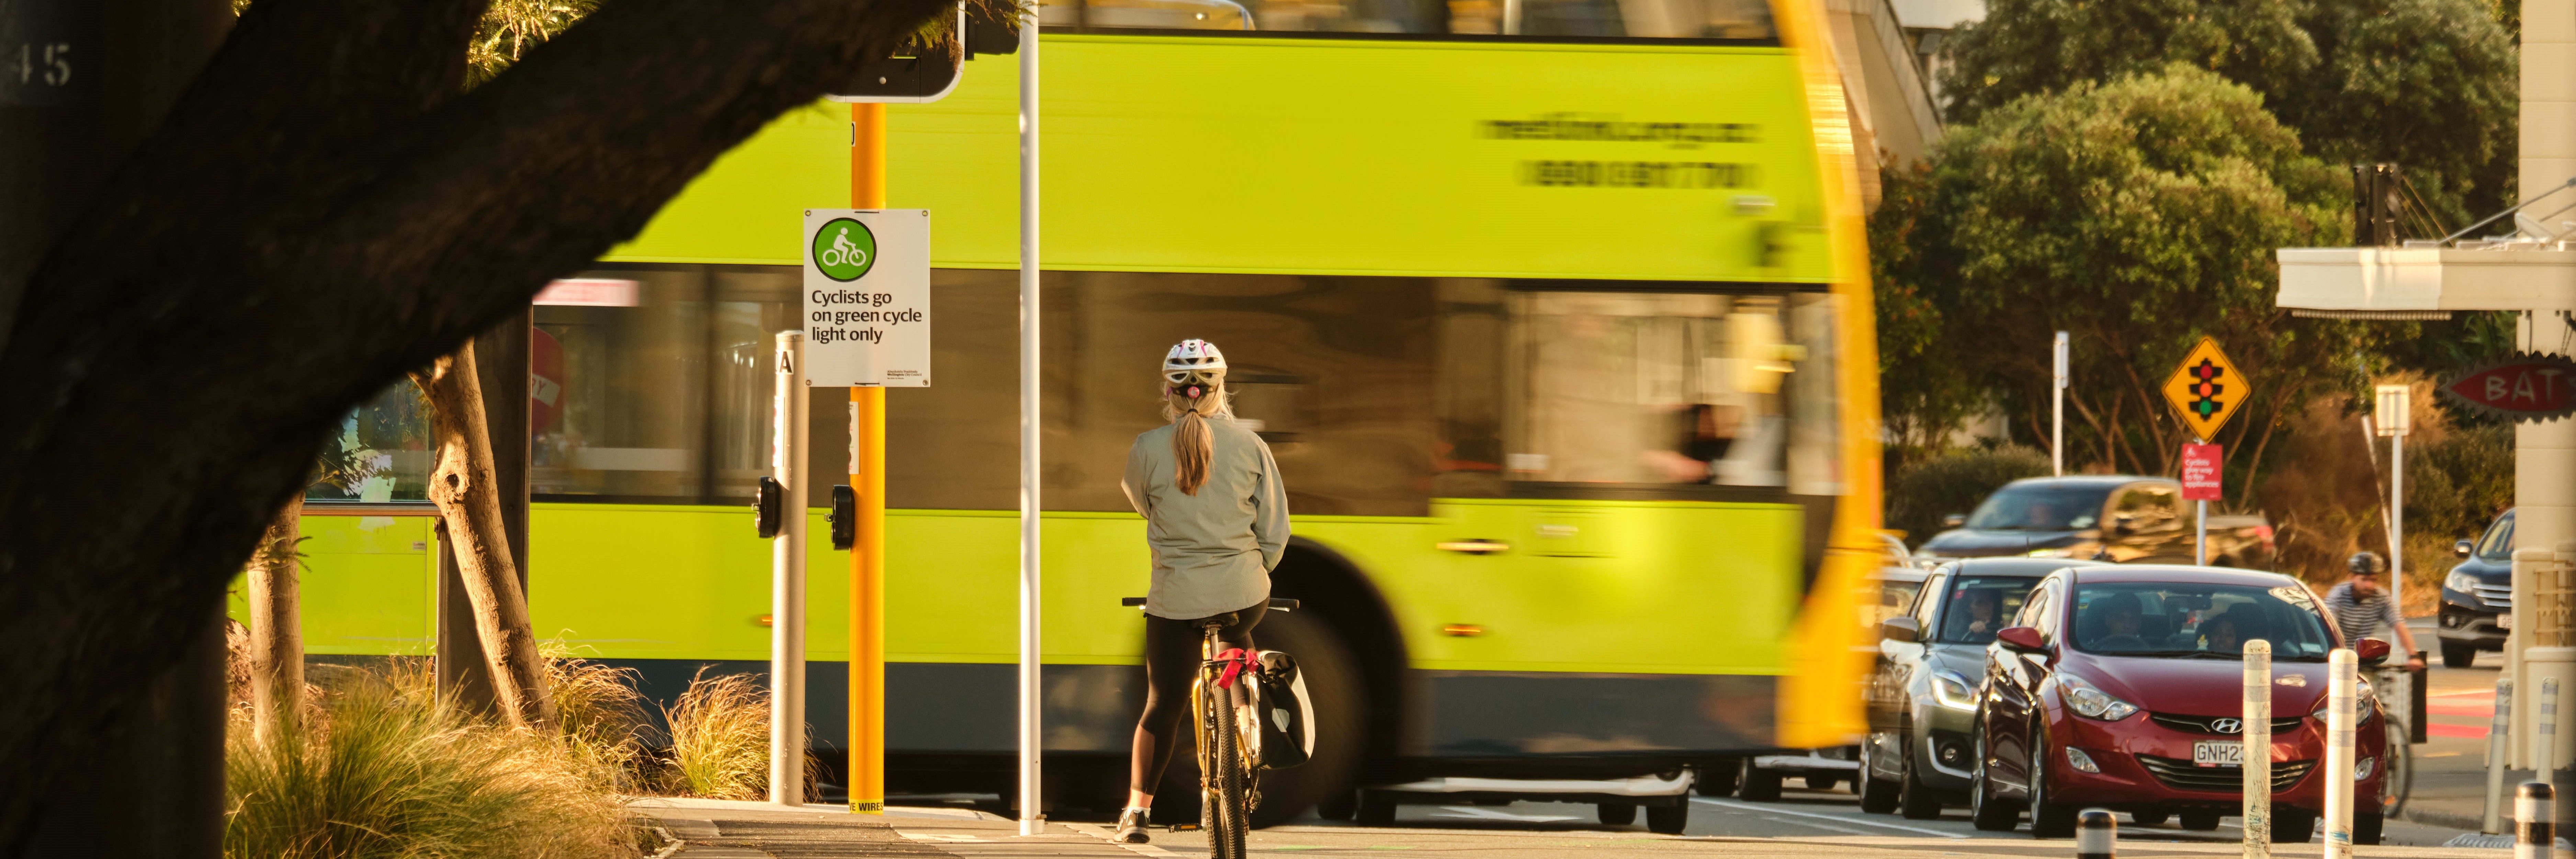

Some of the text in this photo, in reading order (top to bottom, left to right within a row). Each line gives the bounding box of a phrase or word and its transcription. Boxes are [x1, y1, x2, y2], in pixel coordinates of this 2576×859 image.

[812, 290, 892, 307] Cyclists go
[812, 308, 922, 325] on green cycle
[812, 327, 883, 344] light only
[776, 351, 792, 373] A
[859, 802, 883, 811] WIRES
